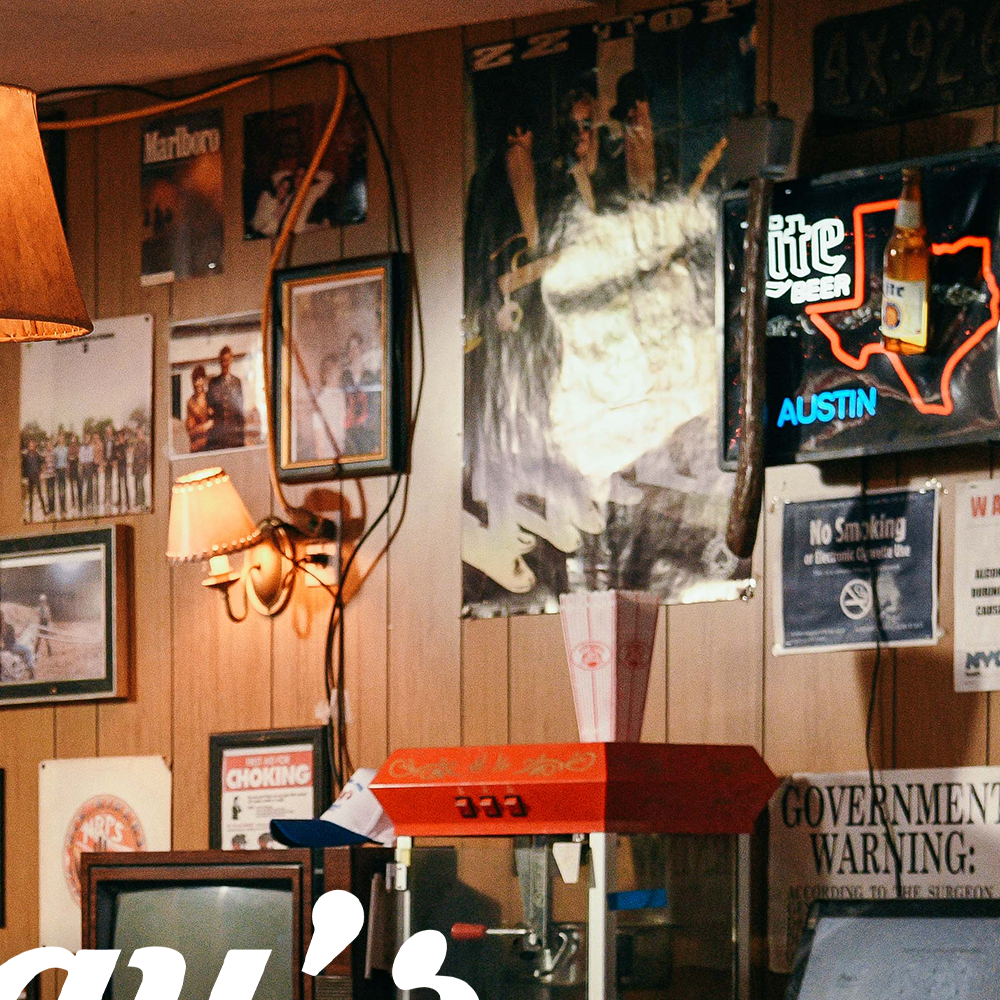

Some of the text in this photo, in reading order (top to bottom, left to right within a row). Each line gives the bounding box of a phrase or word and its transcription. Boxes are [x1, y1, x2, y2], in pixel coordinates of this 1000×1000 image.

[472, 28, 571, 72] ZZ
[143, 125, 221, 164] Marlboro
[767, 213, 847, 280] ite
[790, 273, 851, 304] BEER
[776, 386, 877, 428] AUSTIN
[809, 519, 833, 547] No
[225, 764, 312, 791] CHOKING
[781, 783, 1000, 828] GOVERNMENT
[811, 831, 975, 875] WARNING:
